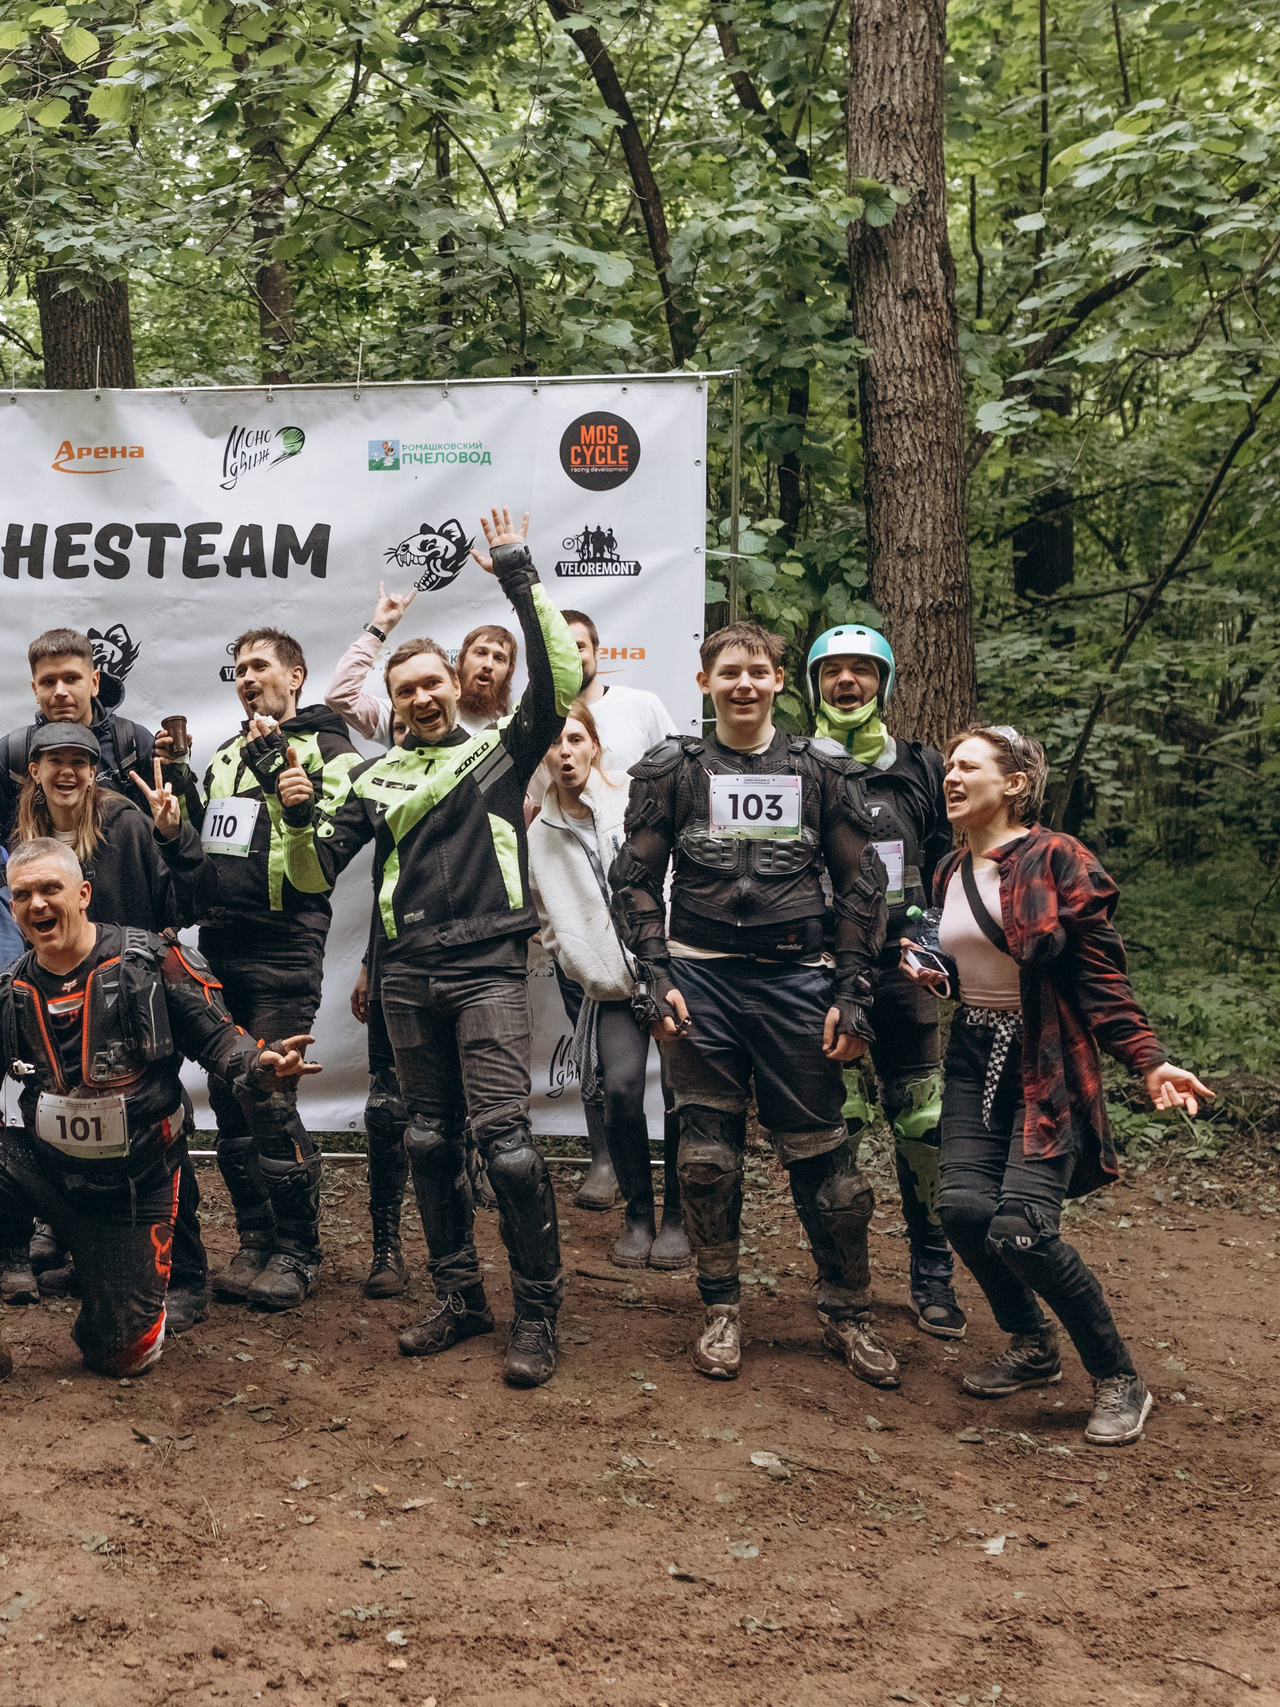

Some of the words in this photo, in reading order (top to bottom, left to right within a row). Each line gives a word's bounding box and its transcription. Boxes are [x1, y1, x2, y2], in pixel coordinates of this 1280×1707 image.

[580, 425, 618, 445] MOS
[53, 440, 145, 461] Арена
[401, 440, 483, 451] РОМАШКОВСКИЙ
[570, 445, 629, 465] CYCLE
[402, 451, 492, 466] ПЧЕЛОВОД
[559, 561, 636, 576] VELOREMONT
[454, 741, 490, 778] SCOYCO
[728, 793, 784, 821] 103
[210, 815, 238, 838] 110
[55, 1114, 103, 1142] 101
